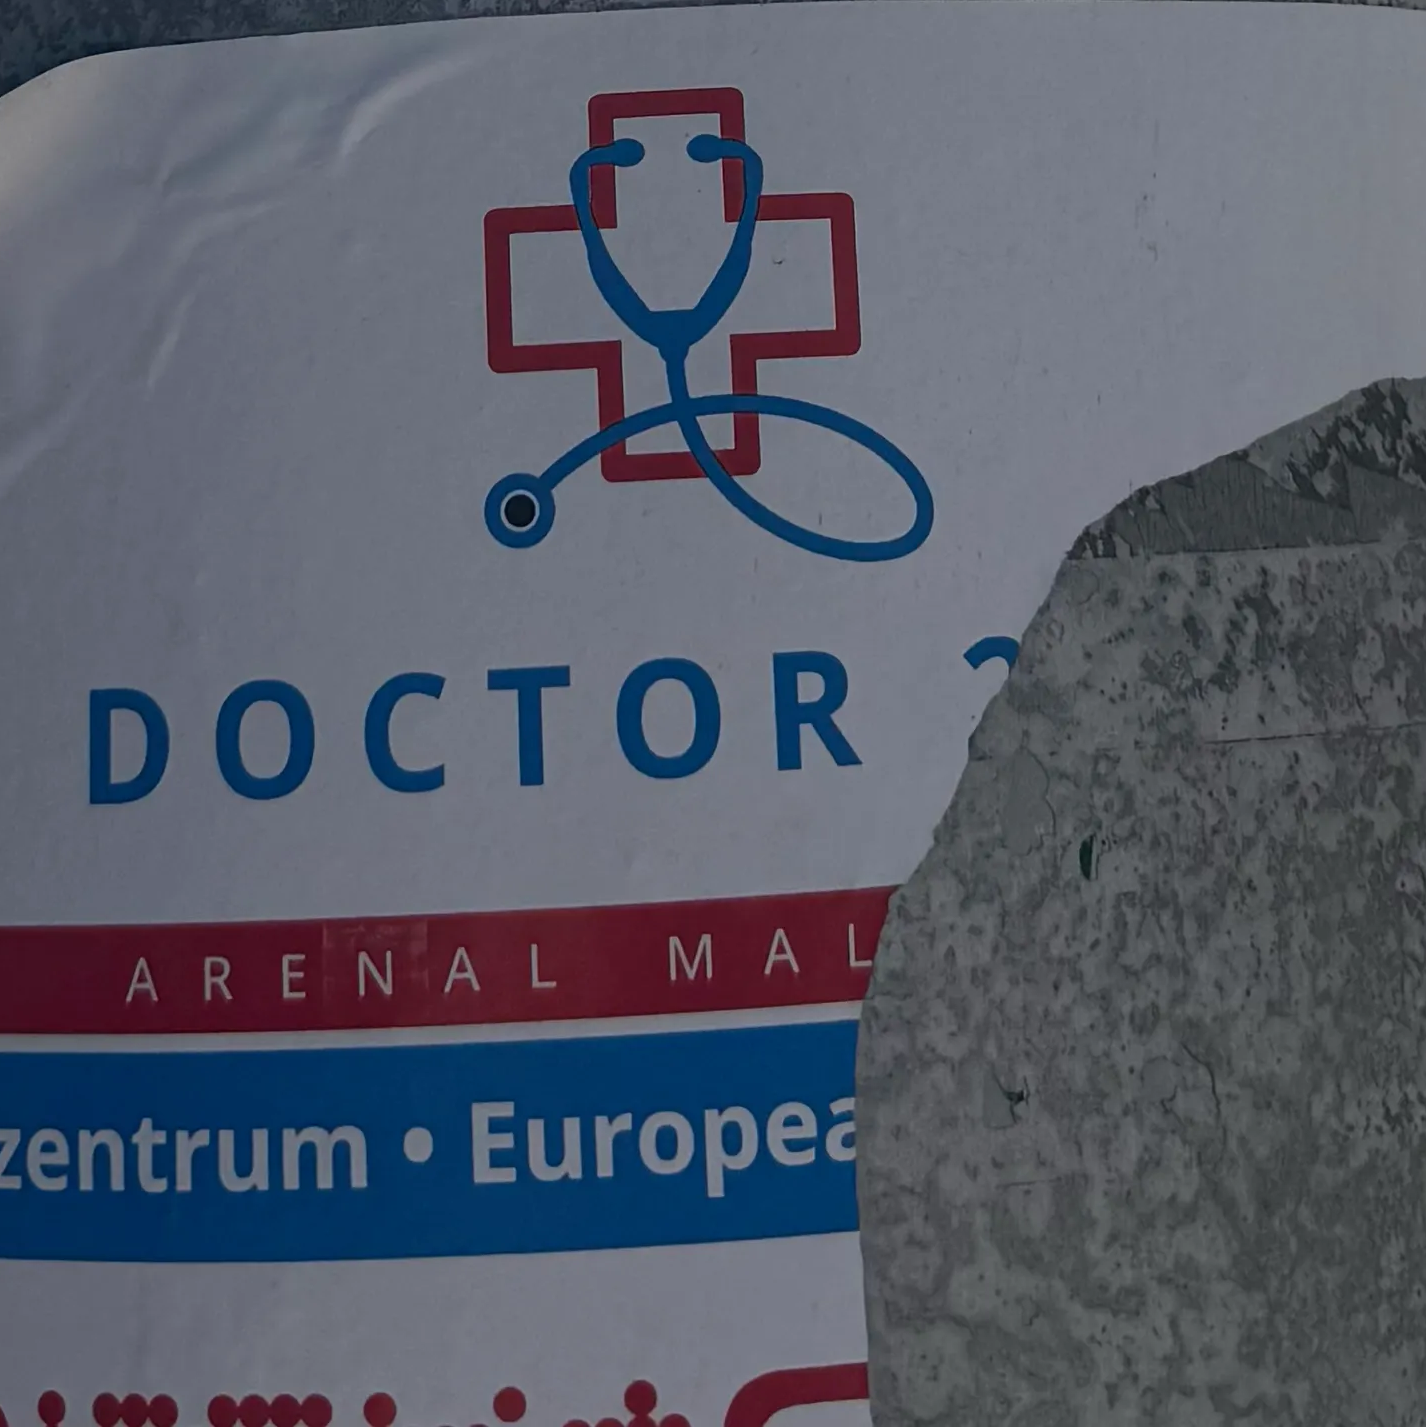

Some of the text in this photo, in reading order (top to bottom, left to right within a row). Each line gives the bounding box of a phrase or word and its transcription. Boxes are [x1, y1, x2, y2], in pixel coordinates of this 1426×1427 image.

[87, 649, 863, 805] DOCTOR
[124, 922, 873, 1004] ARENAL MAL
